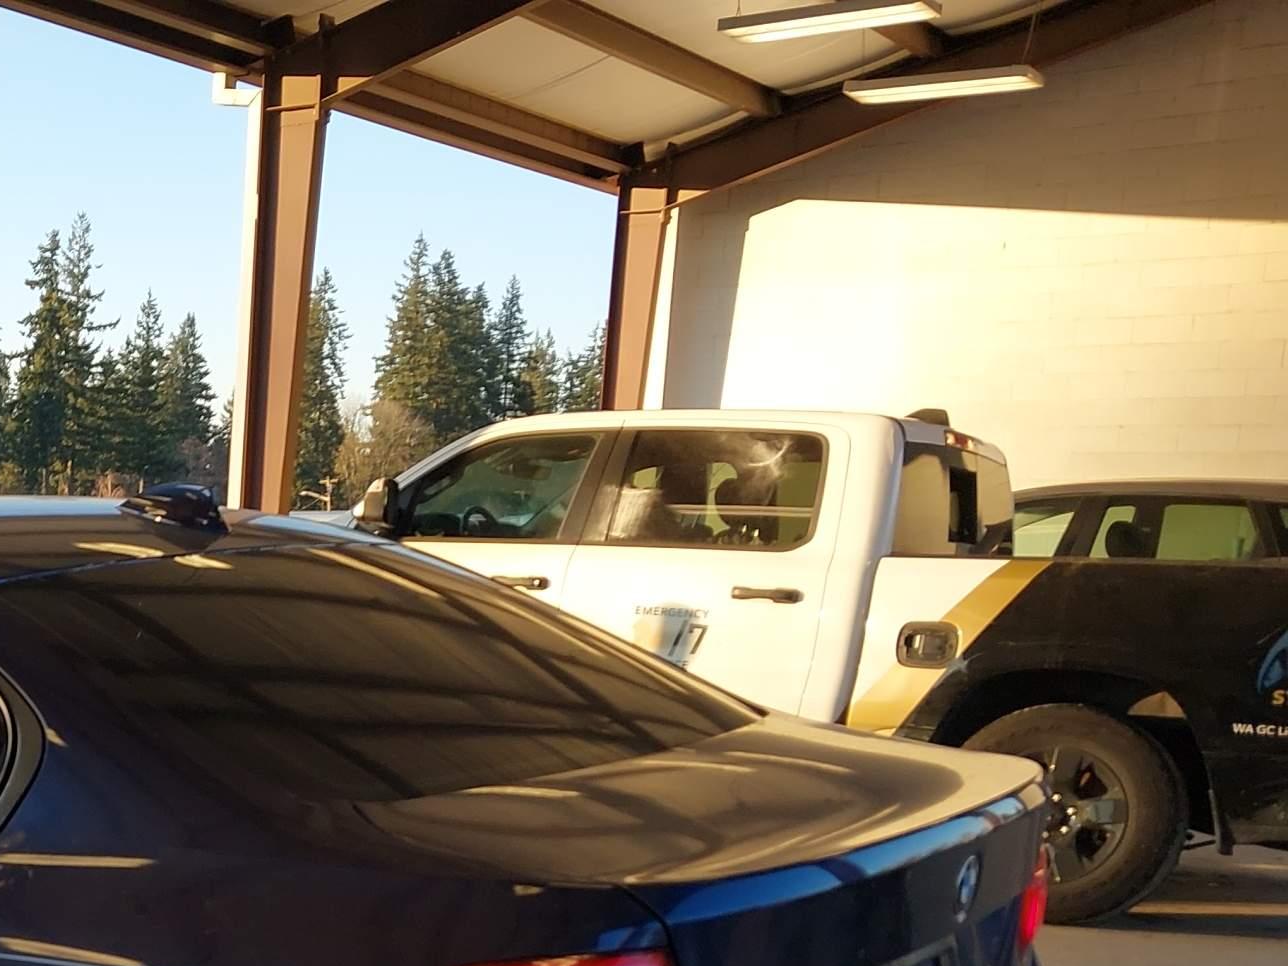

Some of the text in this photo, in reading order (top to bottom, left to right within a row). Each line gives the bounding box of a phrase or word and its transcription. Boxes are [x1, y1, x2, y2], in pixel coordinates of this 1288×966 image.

[634, 605, 709, 619] EMERGENCY
[1232, 723, 1253, 734] WA
[1256, 724, 1276, 735] GC
